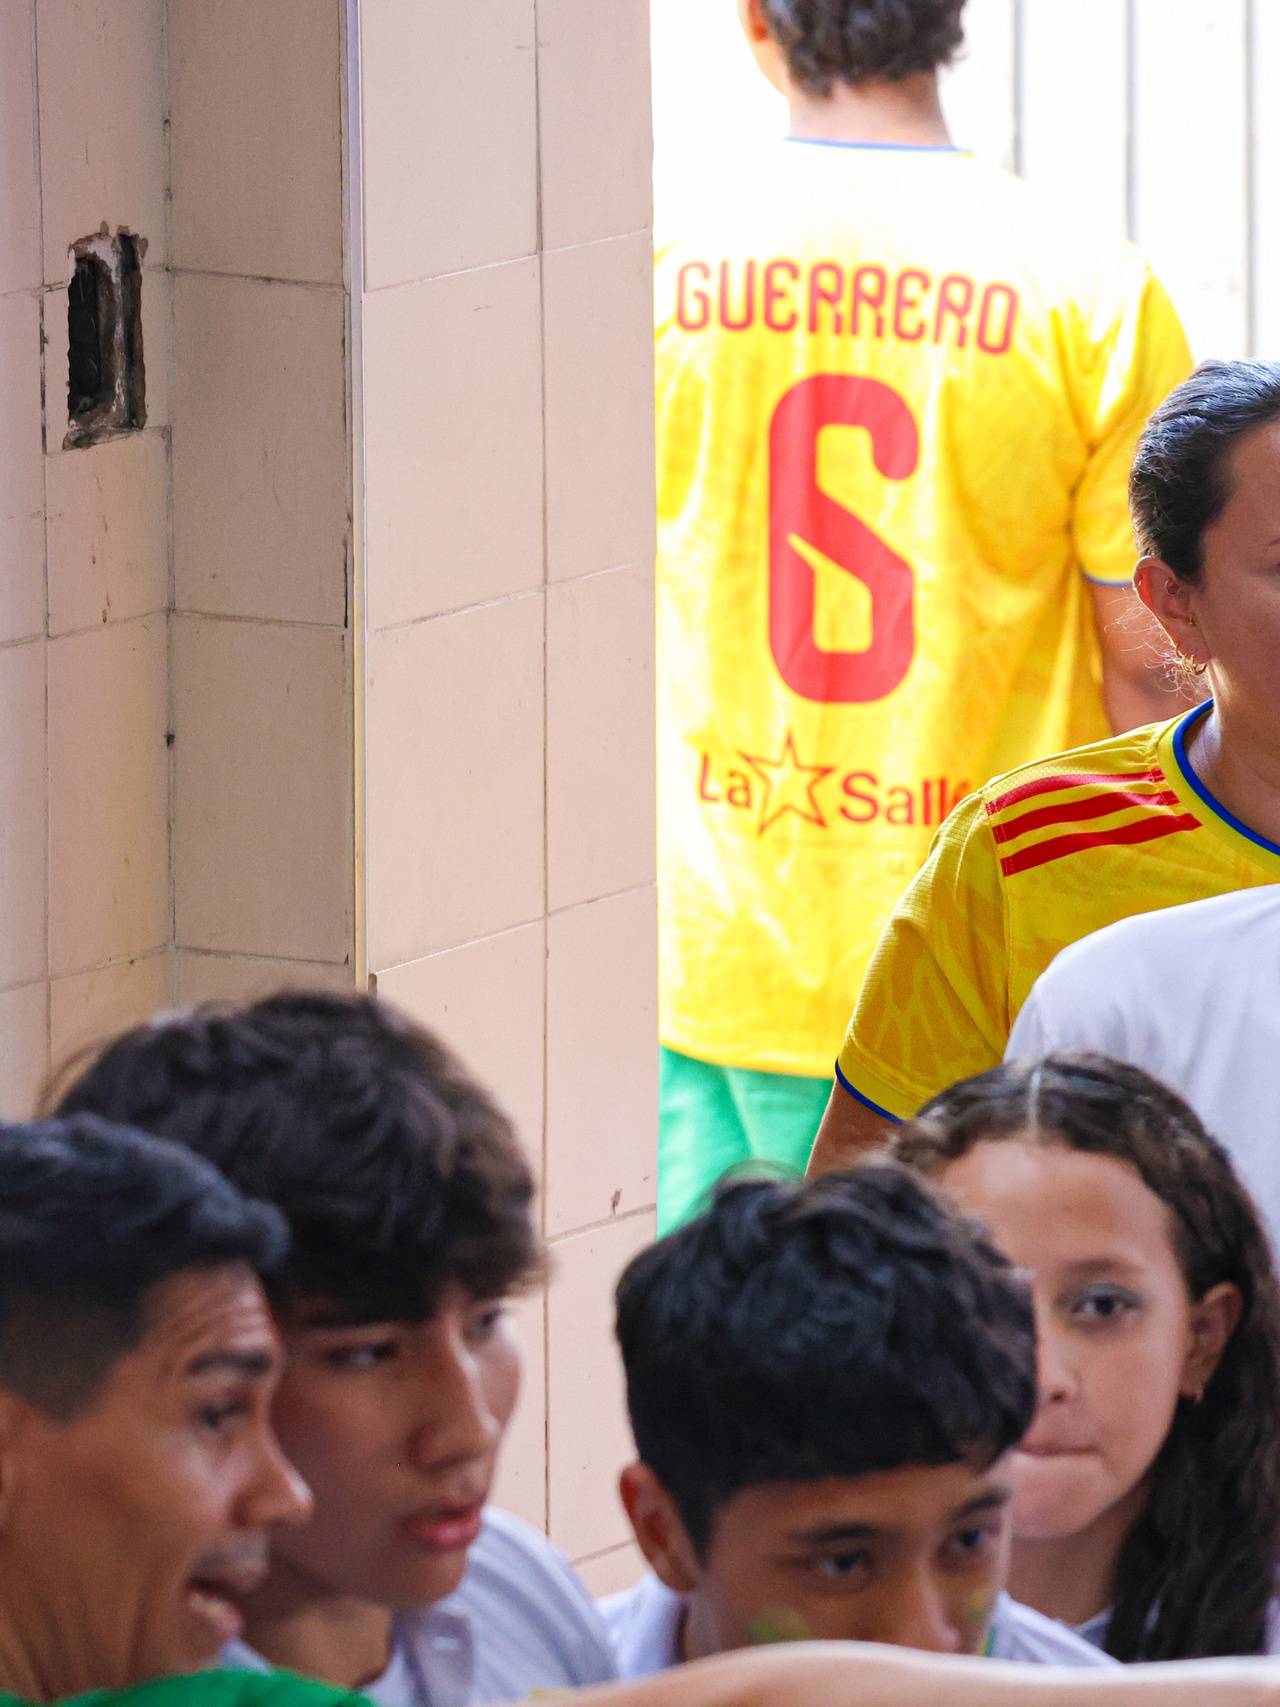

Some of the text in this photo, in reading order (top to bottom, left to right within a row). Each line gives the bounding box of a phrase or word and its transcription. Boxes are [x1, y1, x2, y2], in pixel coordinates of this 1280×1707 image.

[676, 259, 1019, 355] GUERRERO
[768, 372, 920, 705] 6
[698, 752, 752, 810] La
